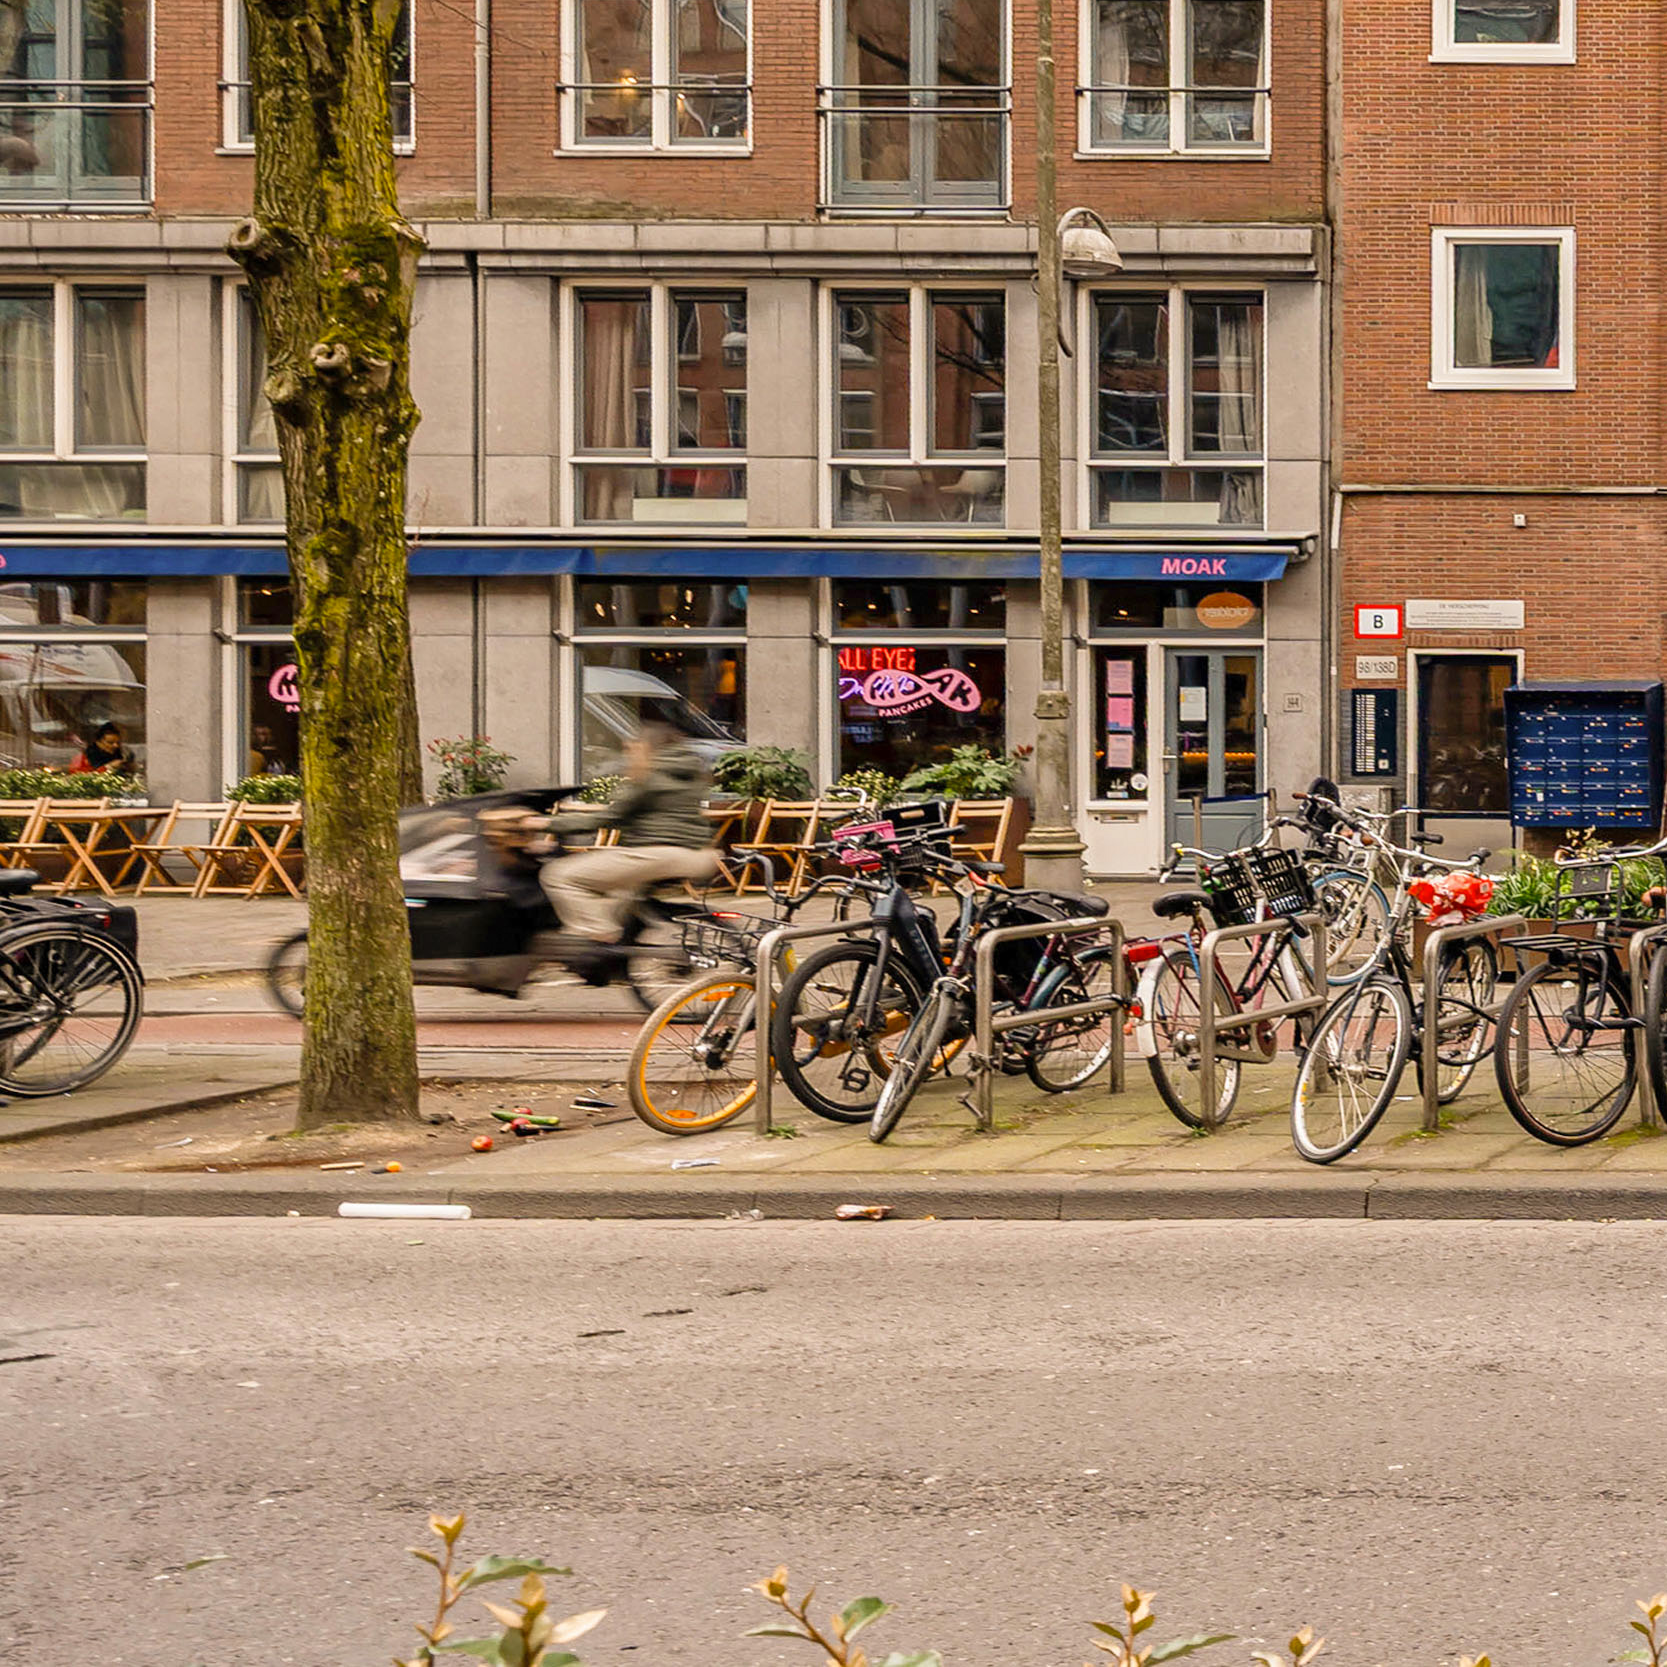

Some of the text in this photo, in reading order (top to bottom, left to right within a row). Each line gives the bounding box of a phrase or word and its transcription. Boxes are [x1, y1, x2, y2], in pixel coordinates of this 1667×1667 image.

[1160, 557, 1227, 575] MOAK
[1373, 615, 1384, 629] B
[878, 696, 934, 717] PANCAKES
